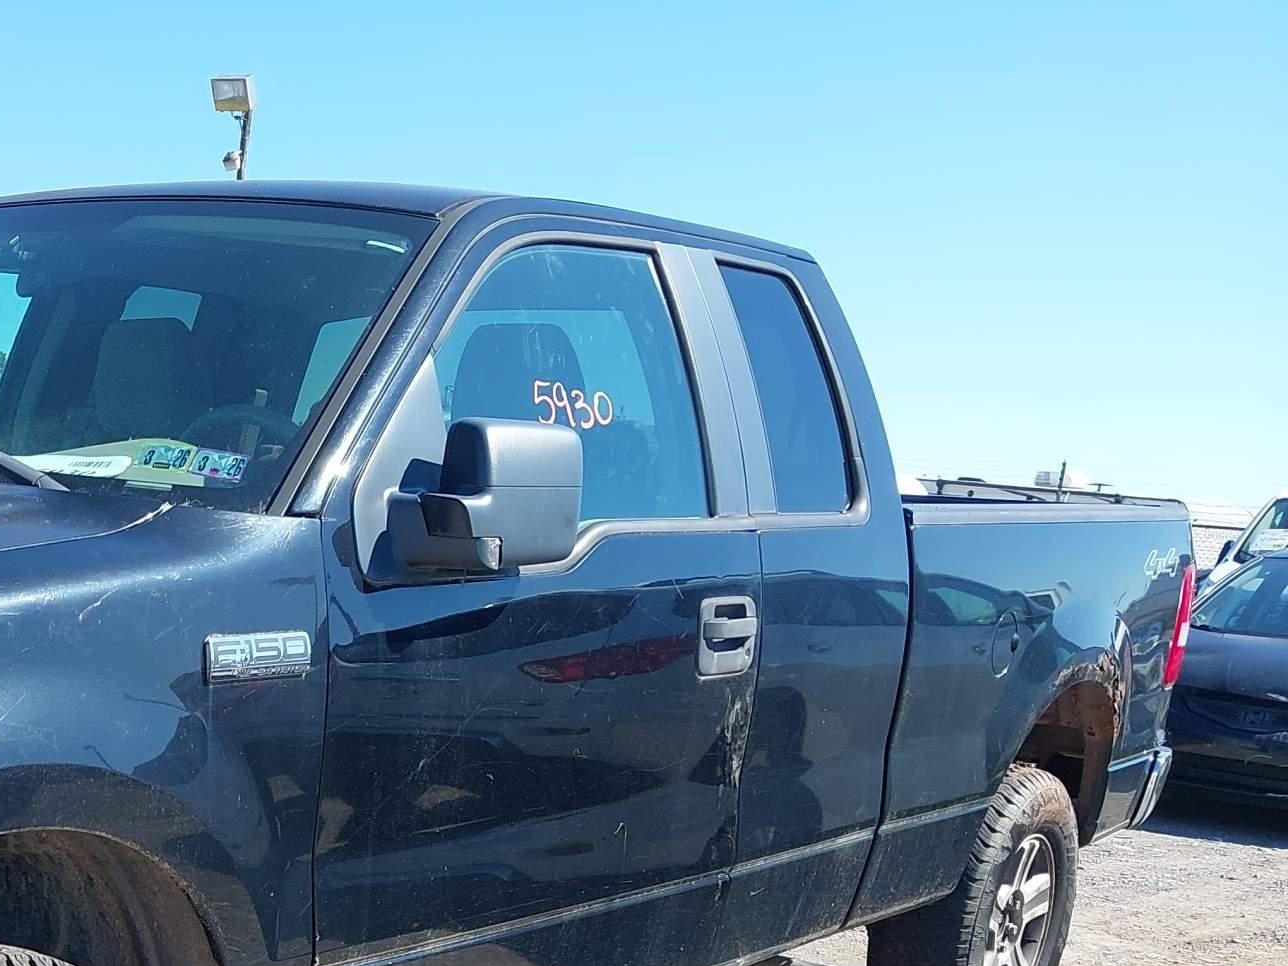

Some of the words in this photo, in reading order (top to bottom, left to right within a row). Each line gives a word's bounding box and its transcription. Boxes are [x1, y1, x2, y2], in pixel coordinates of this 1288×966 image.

[533, 379, 613, 430] 5930
[143, 449, 156, 466] 3
[171, 448, 192, 469] 26
[197, 455, 210, 472] 3
[226, 457, 246, 477] 26
[1143, 547, 1180, 581] 4x4
